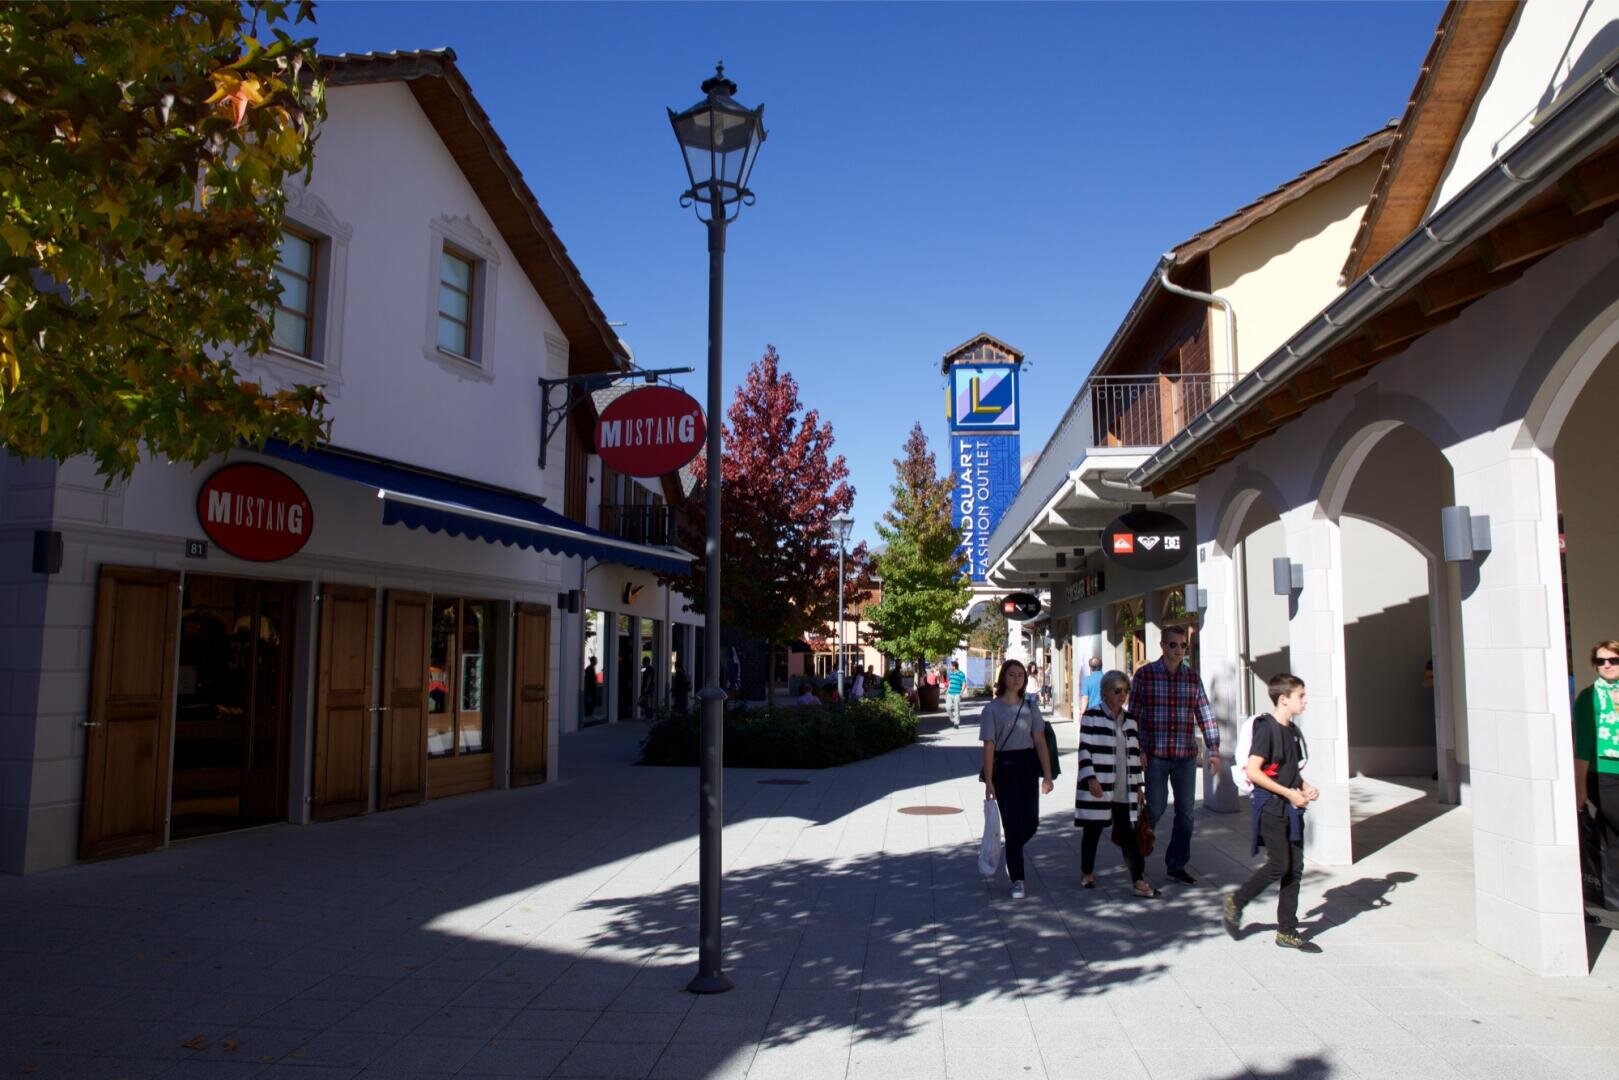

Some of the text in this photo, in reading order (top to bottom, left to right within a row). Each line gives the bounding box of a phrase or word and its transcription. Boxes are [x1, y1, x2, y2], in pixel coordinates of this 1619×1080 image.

[600, 415, 695, 448] MUSTANG
[207, 490, 303, 534] MUSTANG
[976, 441, 990, 576] FASHION OUTLET
[191, 543, 202, 555] 81
